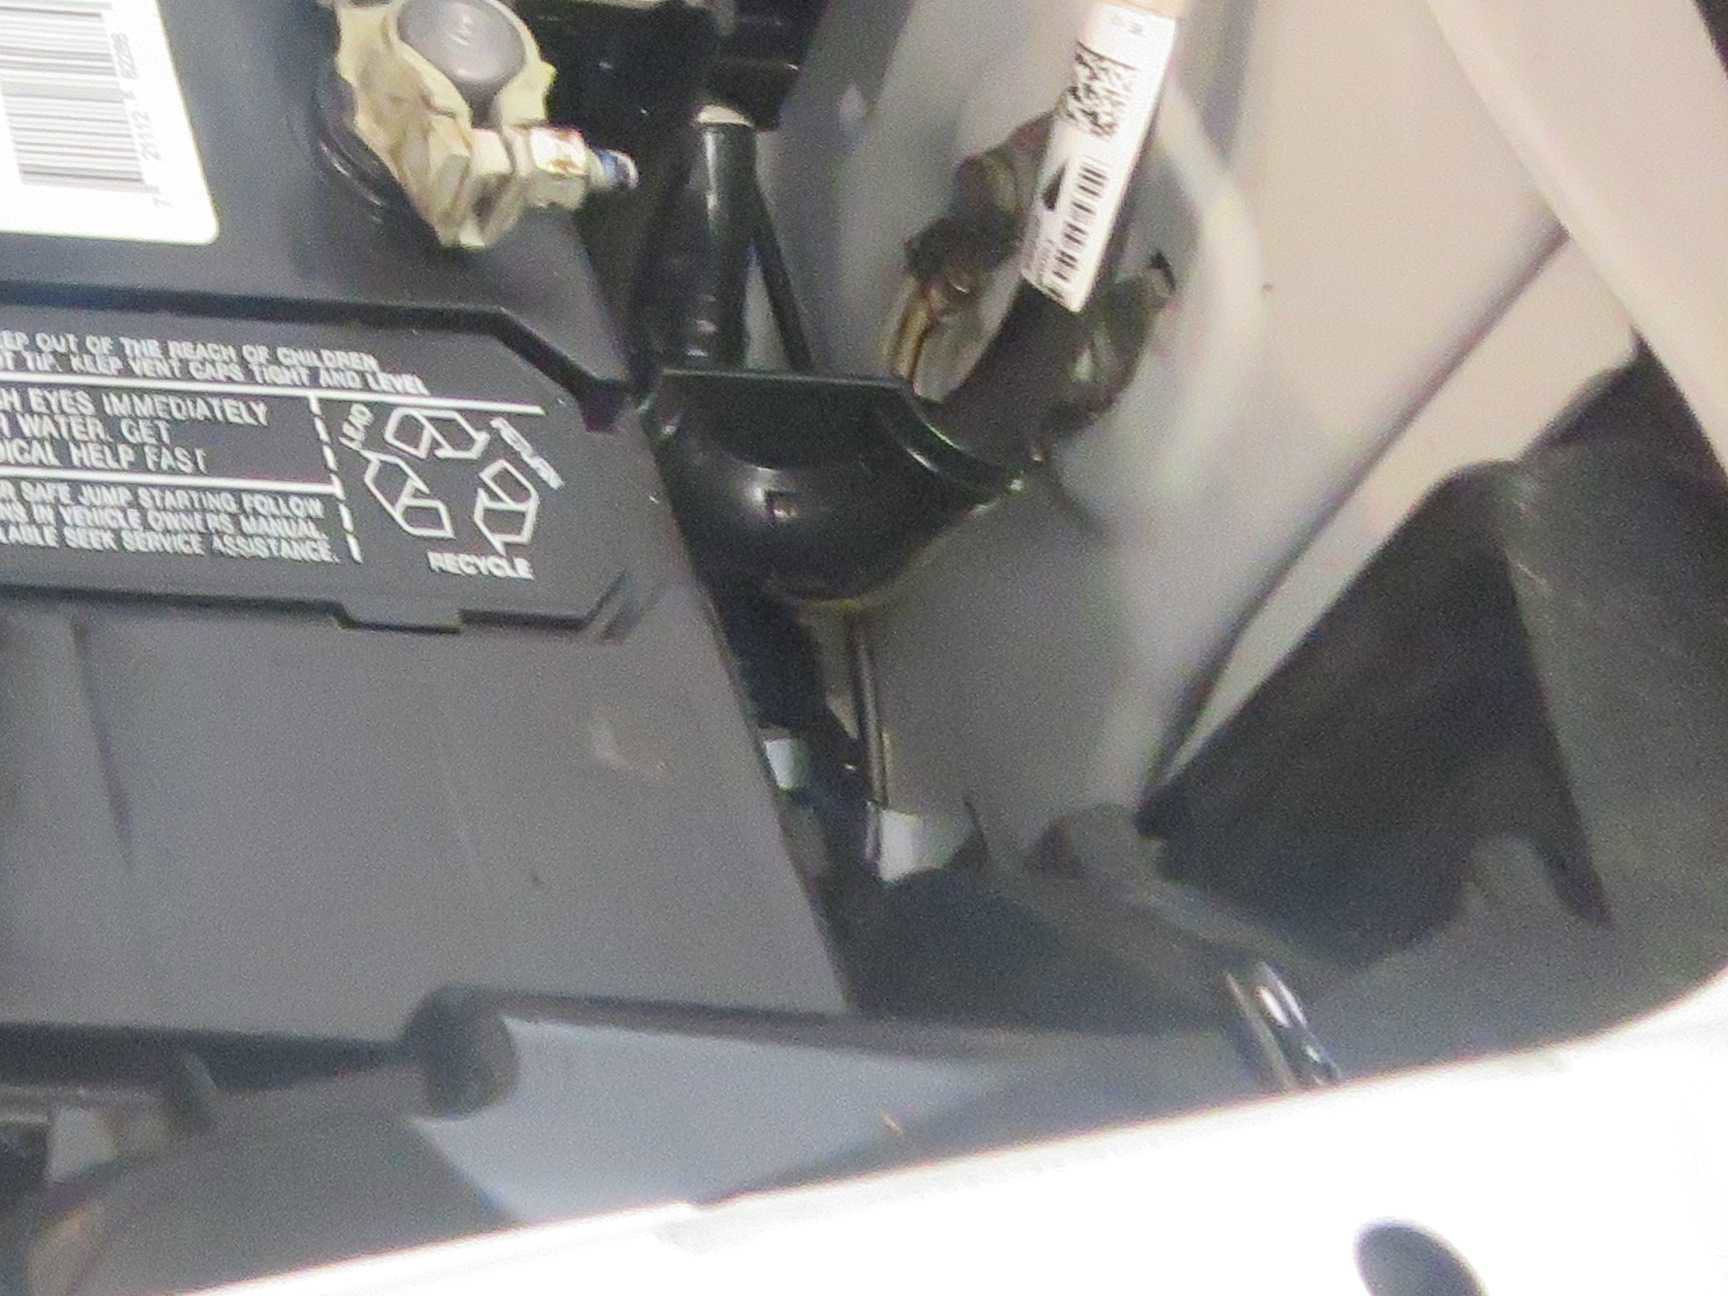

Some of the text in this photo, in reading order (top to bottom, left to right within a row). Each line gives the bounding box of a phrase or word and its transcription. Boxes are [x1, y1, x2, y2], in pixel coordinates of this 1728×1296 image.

[35, 332, 79, 354] OUT
[85, 335, 113, 355] OF
[118, 336, 160, 358] THE
[167, 340, 237, 363] REACH
[242, 344, 271, 364] OF
[276, 346, 380, 372] CHILDREN
[69, 353, 124, 375] KEEP
[127, 356, 182, 378] VENT
[188, 361, 244, 382] CAPS
[248, 363, 310, 386] TIGHT
[319, 367, 363, 389] AND
[366, 370, 431, 396] LEVEL
[27, 387, 95, 415] EYES
[101, 392, 269, 426] IMMEDIATELY
[120, 418, 170, 445] GET
[68, 441, 135, 470] HELP
[144, 444, 209, 475] FAST
[19, 480, 73, 505] SAFE
[78, 484, 134, 508] JUMP
[137, 487, 240, 514] STARTING
[242, 492, 325, 519] FOLLOW
[31, 503, 56, 525] IN
[58, 504, 141, 530] VEHICLE
[63, 525, 119, 551] SEEK
[121, 531, 205, 555] SERVICE
[426, 551, 534, 581] RECYCLE
